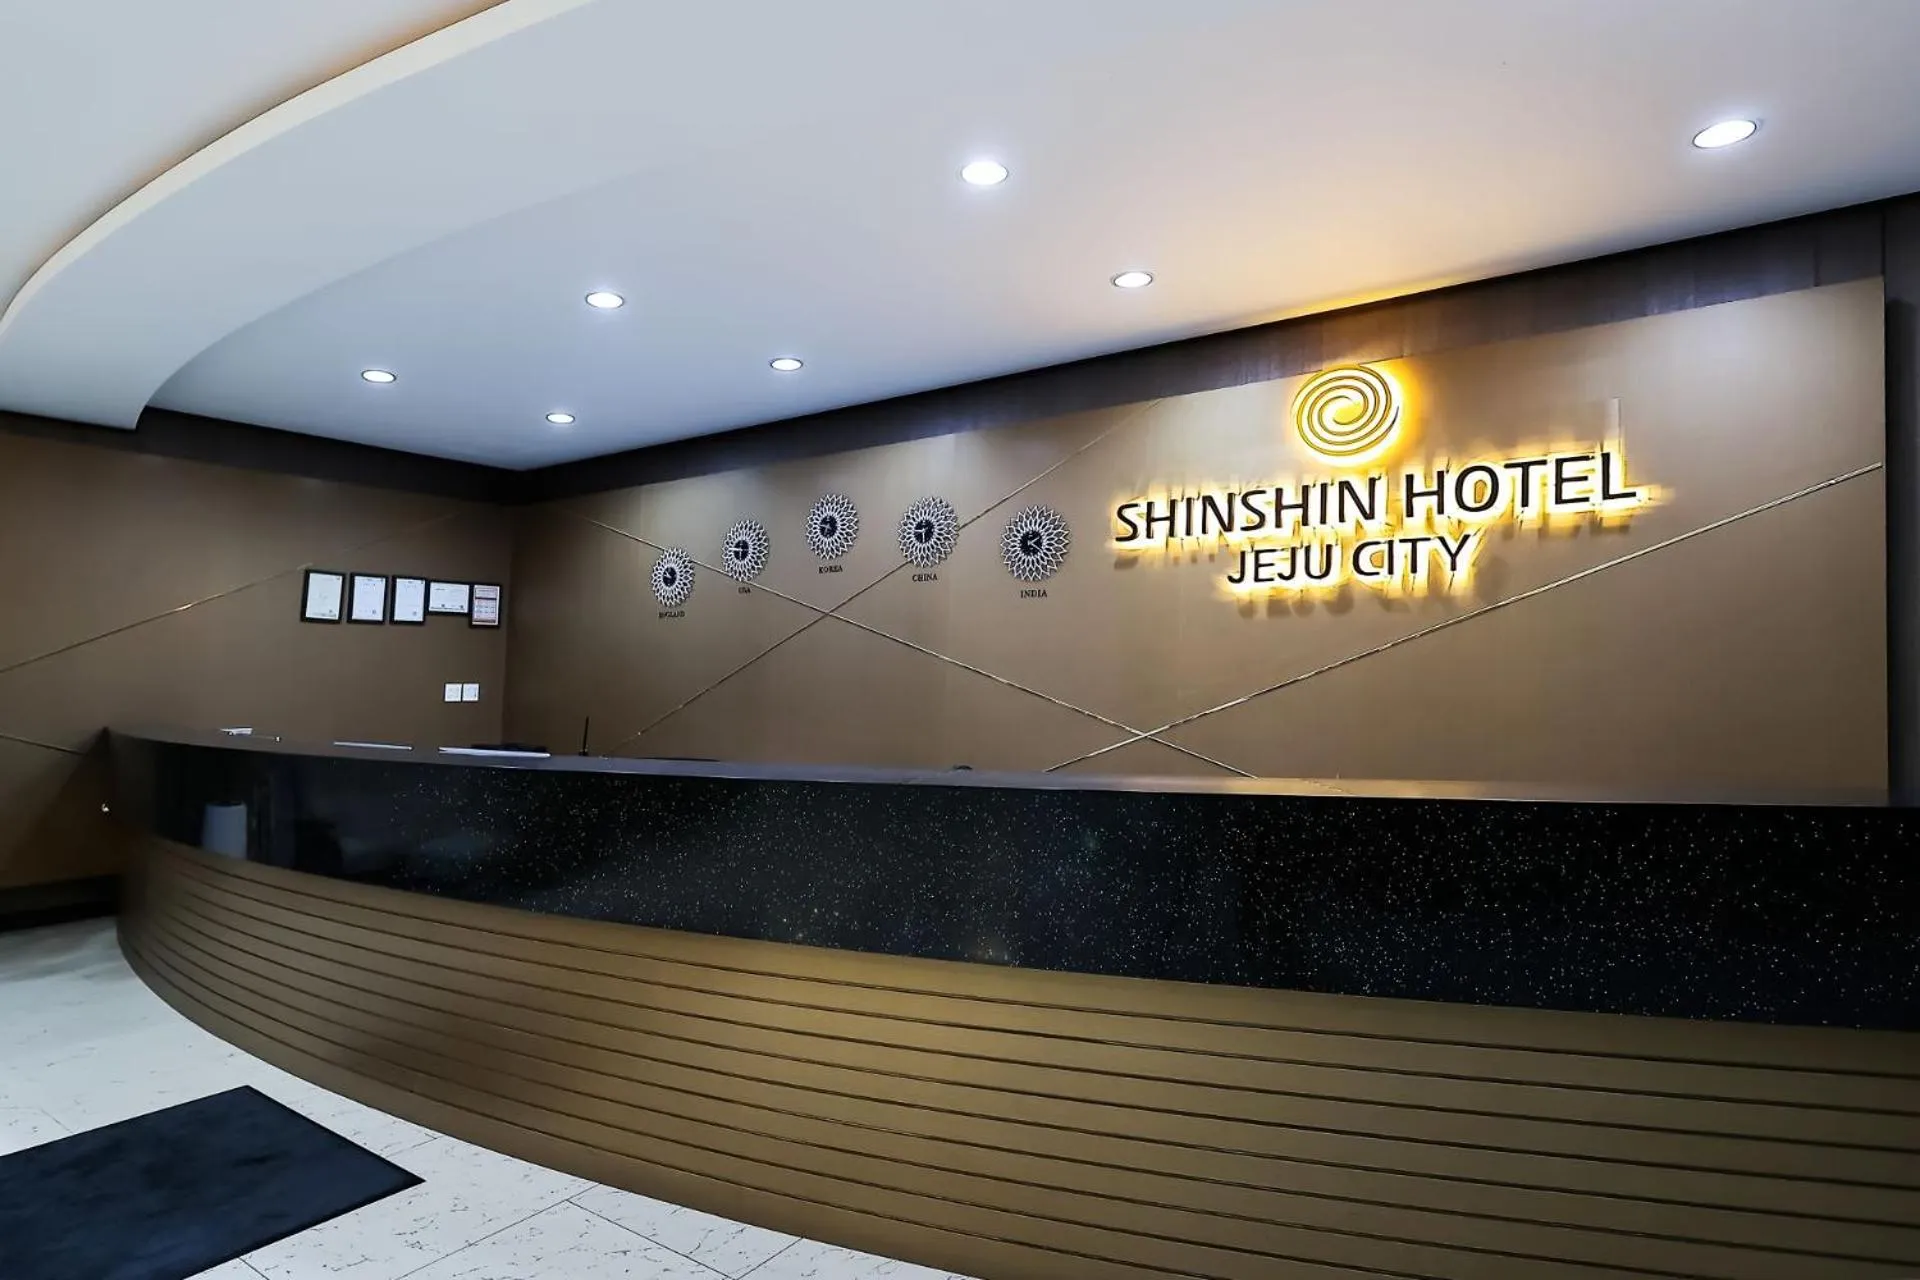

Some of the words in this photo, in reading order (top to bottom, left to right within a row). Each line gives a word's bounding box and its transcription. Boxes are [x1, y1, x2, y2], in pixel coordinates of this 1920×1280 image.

[1115, 476, 1377, 543] SHINSHIN
[1404, 452, 1637, 519] HOTEL
[1227, 543, 1333, 585] JEJU
[1352, 533, 1471, 577] CITY
[818, 564, 843, 574] KOREA
[911, 573, 938, 582] CHINA
[1020, 589, 1048, 599] INDIA
